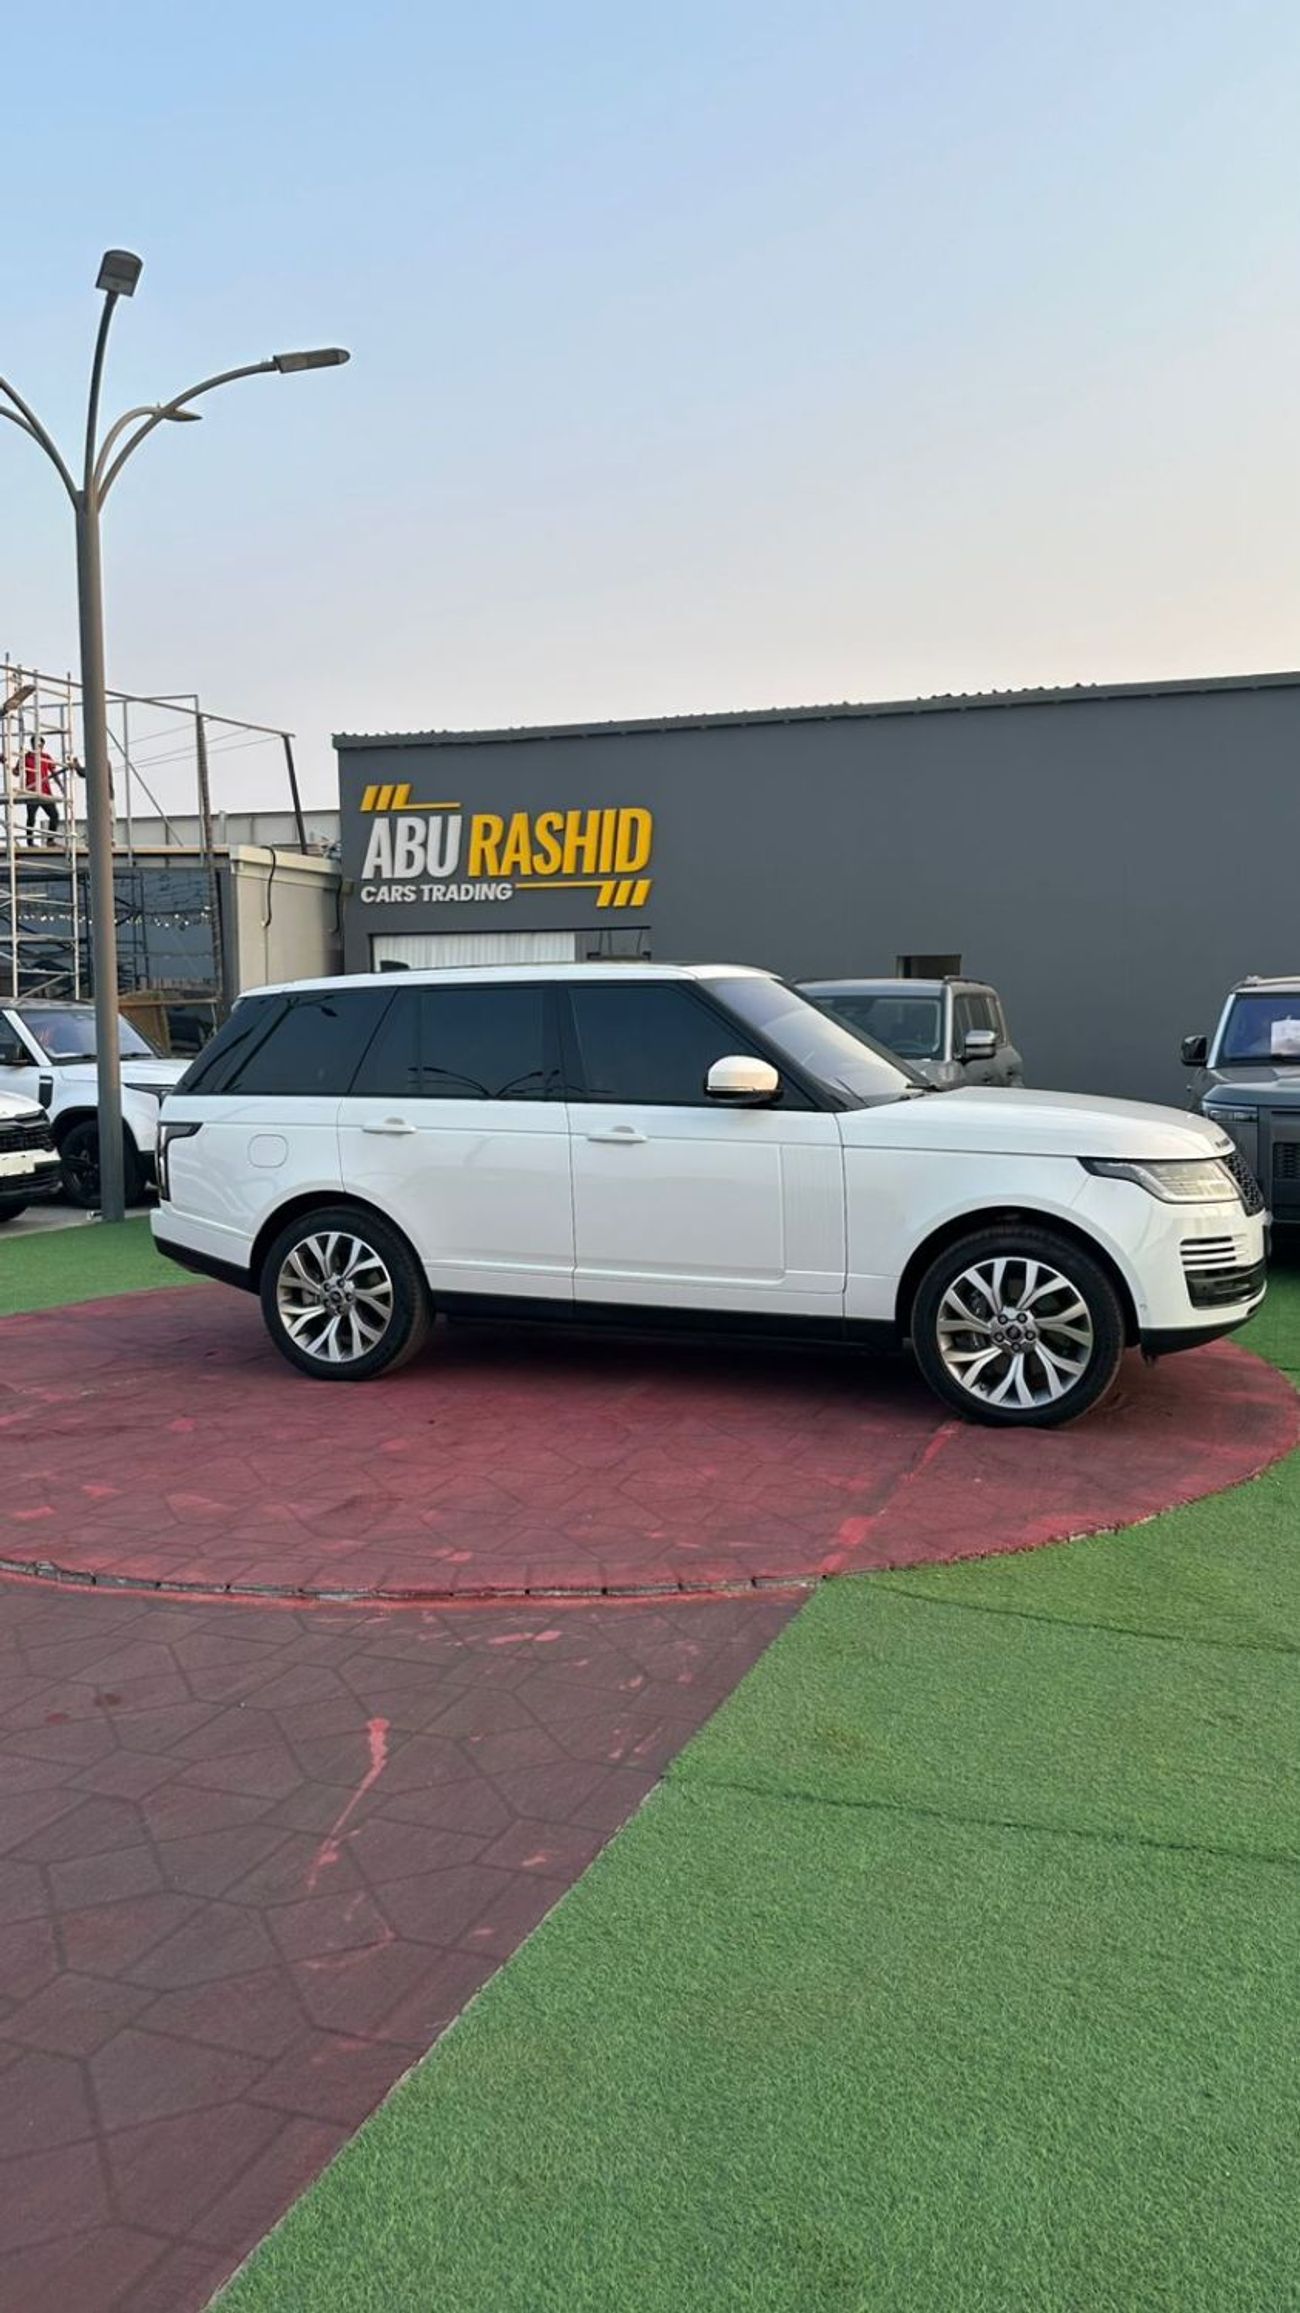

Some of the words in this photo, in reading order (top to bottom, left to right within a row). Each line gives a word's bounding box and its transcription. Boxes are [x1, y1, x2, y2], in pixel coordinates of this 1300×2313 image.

[361, 815, 462, 880] ABU
[467, 808, 653, 877] RASHID
[360, 884, 417, 903] CARS
[420, 883, 513, 902] TRADING
